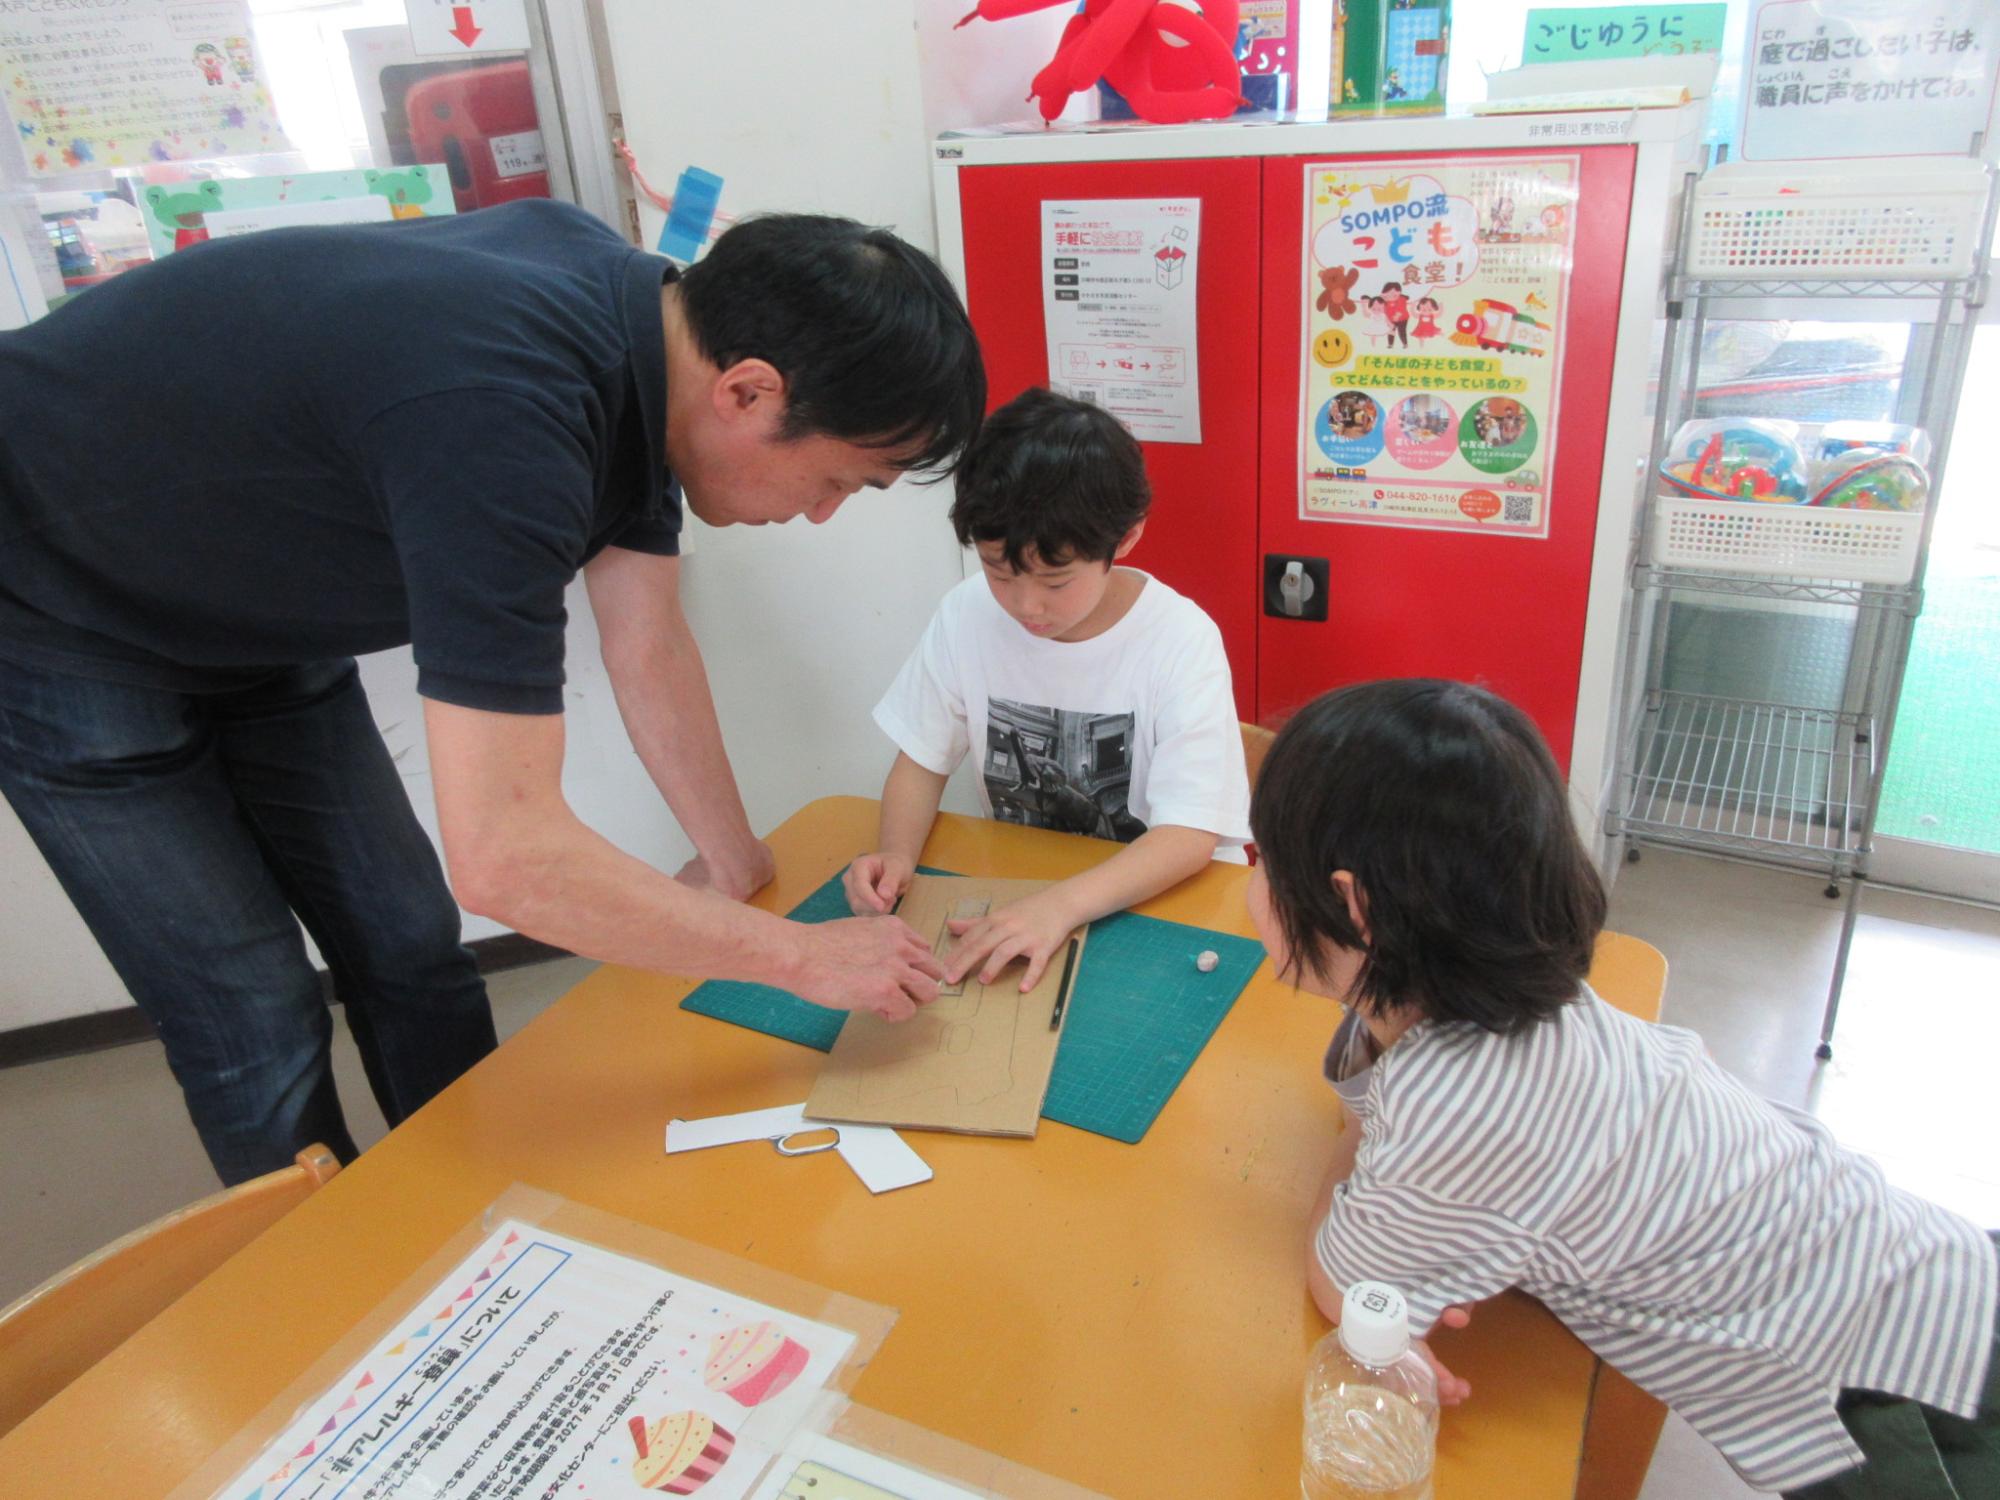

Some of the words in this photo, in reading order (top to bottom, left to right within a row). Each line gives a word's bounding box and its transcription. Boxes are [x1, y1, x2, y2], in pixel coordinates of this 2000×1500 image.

[1534, 16, 1684, 52] ごじゅうに
[1755, 76, 1977, 107] 職員に声をかけてね。
[1341, 193, 1449, 233] SOMPO流
[1352, 222, 1461, 268] こども
[1362, 356, 1494, 373] 「そんぽの子ども食堂」
[1334, 374, 1523, 391] ってどんなことをやっているの？
[1386, 490, 1457, 504] 044-820-1616
[299, 1286, 522, 1499] ー「非アレルギー登録」について
